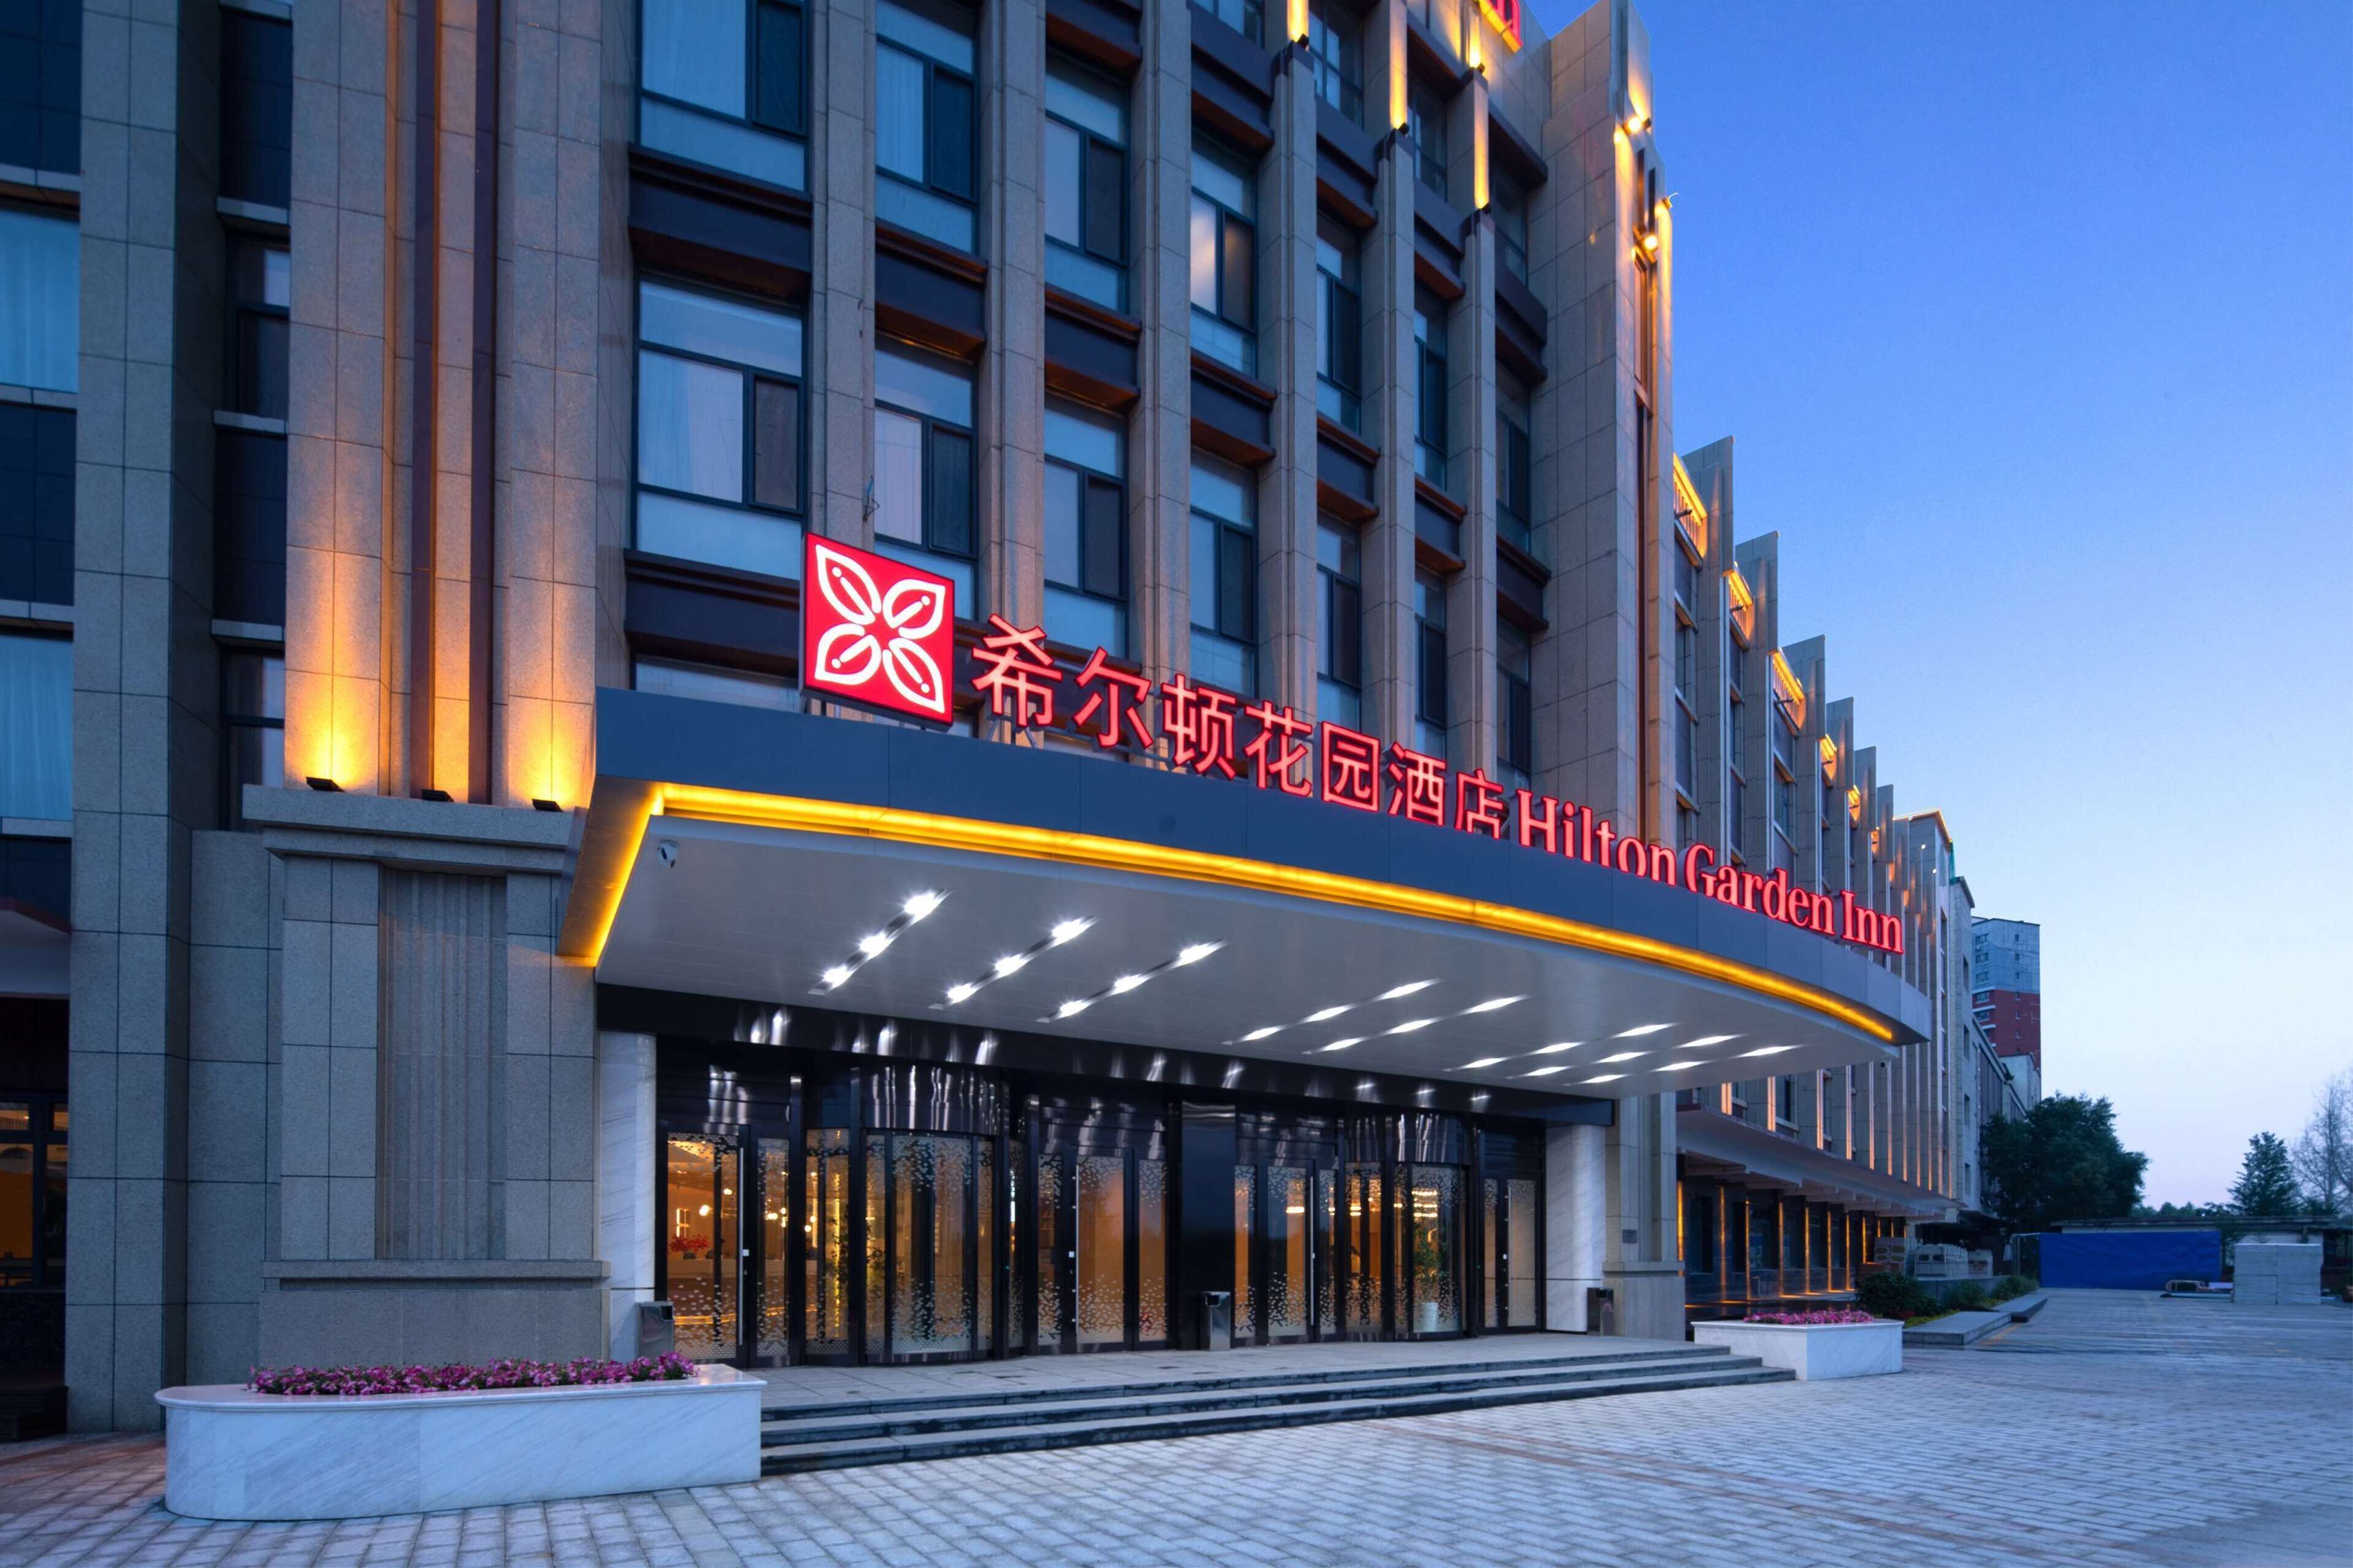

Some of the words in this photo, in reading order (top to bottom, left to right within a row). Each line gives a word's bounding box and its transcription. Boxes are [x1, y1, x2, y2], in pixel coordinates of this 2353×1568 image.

[971, 612, 1504, 841] 希尔顿花园酒店
[1516, 789, 1678, 887] Hilton
[1684, 843, 1836, 936] Garden
[1840, 889, 1904, 955] Inn
